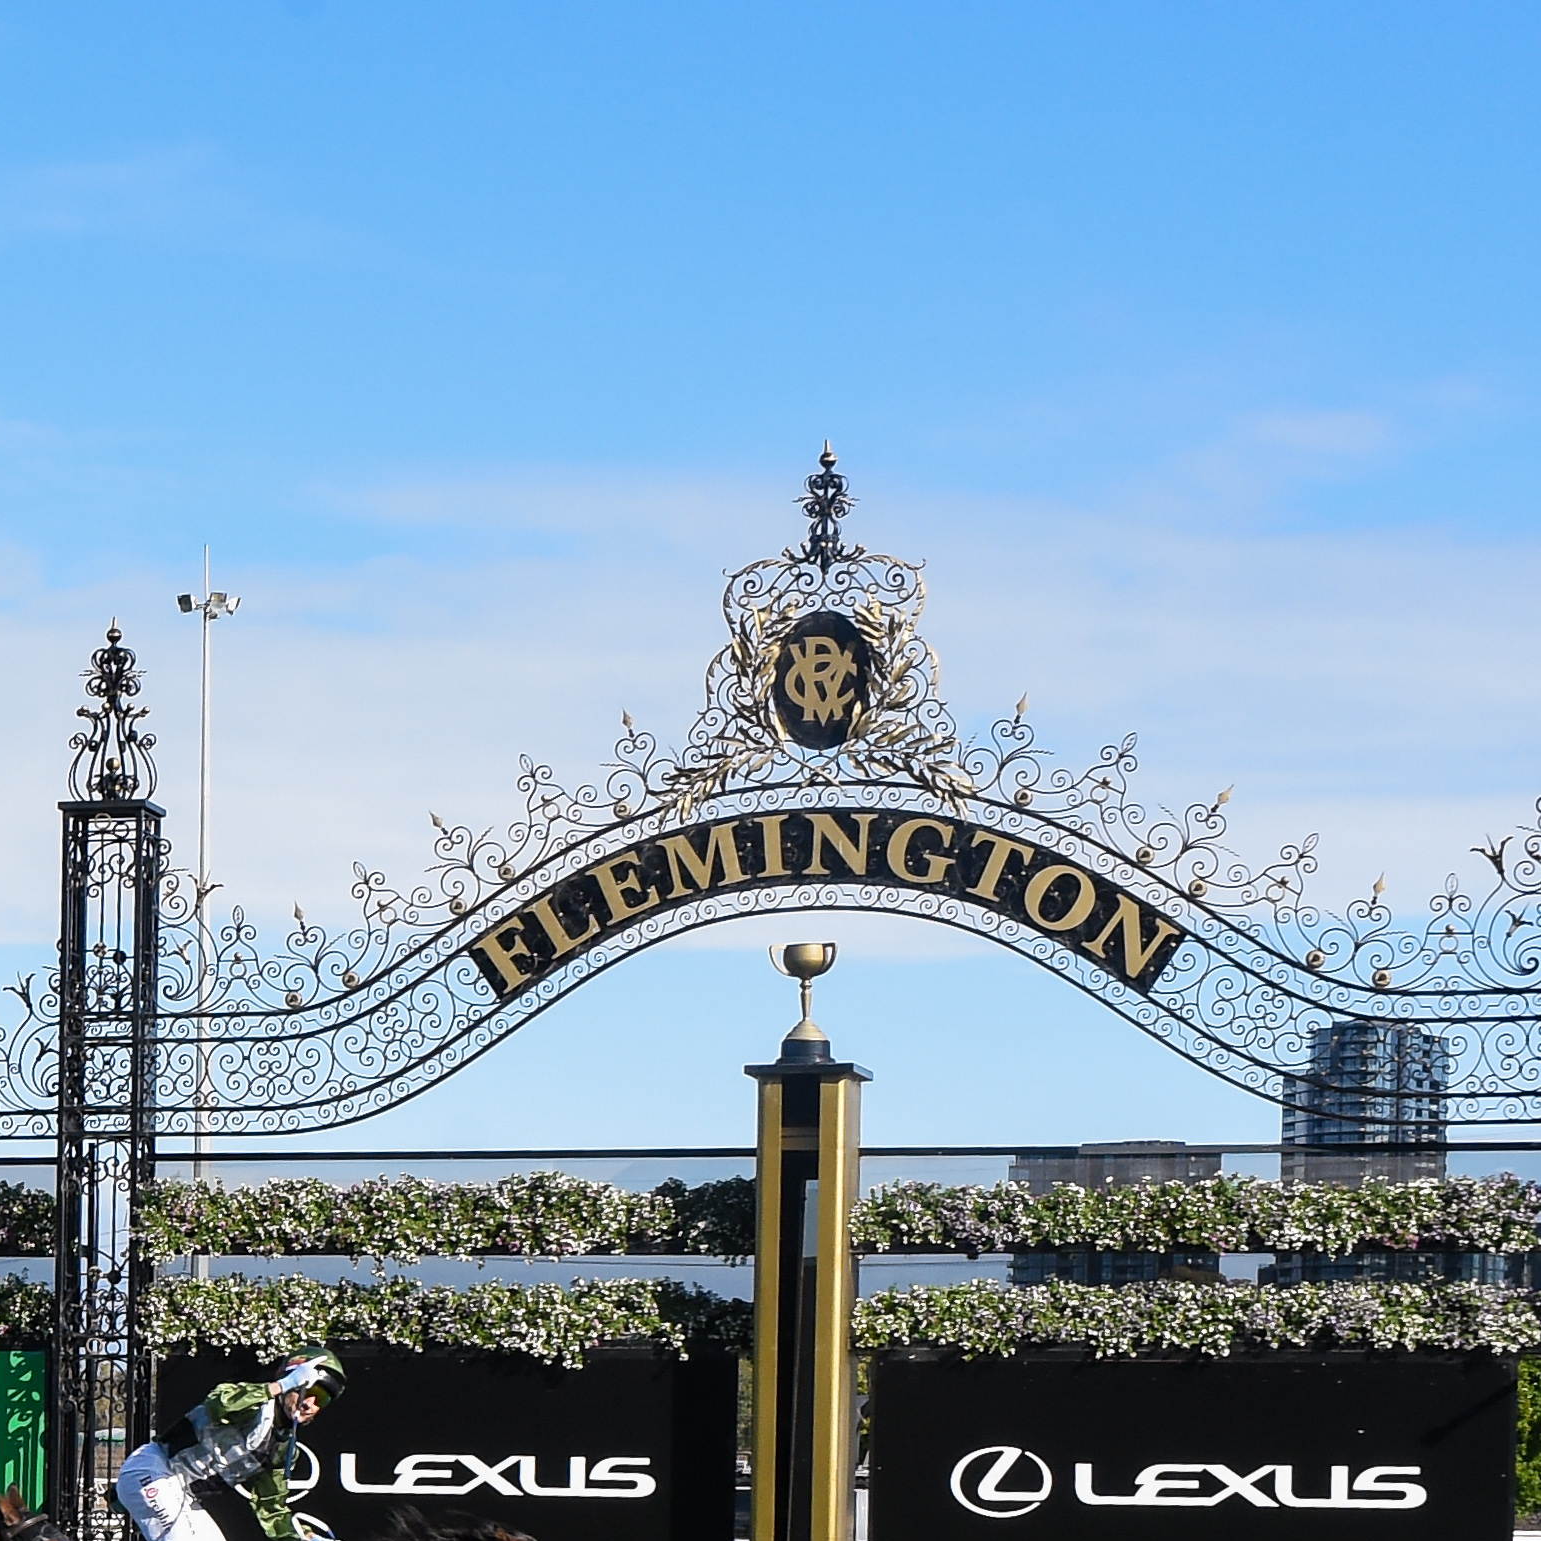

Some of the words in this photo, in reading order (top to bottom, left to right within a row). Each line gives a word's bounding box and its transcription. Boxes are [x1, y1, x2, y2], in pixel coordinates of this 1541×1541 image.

[471, 811, 1182, 993] FLEMINGTON
[340, 1453, 657, 1498] LEXUS
[1074, 1462, 1427, 1508] LEXUS
